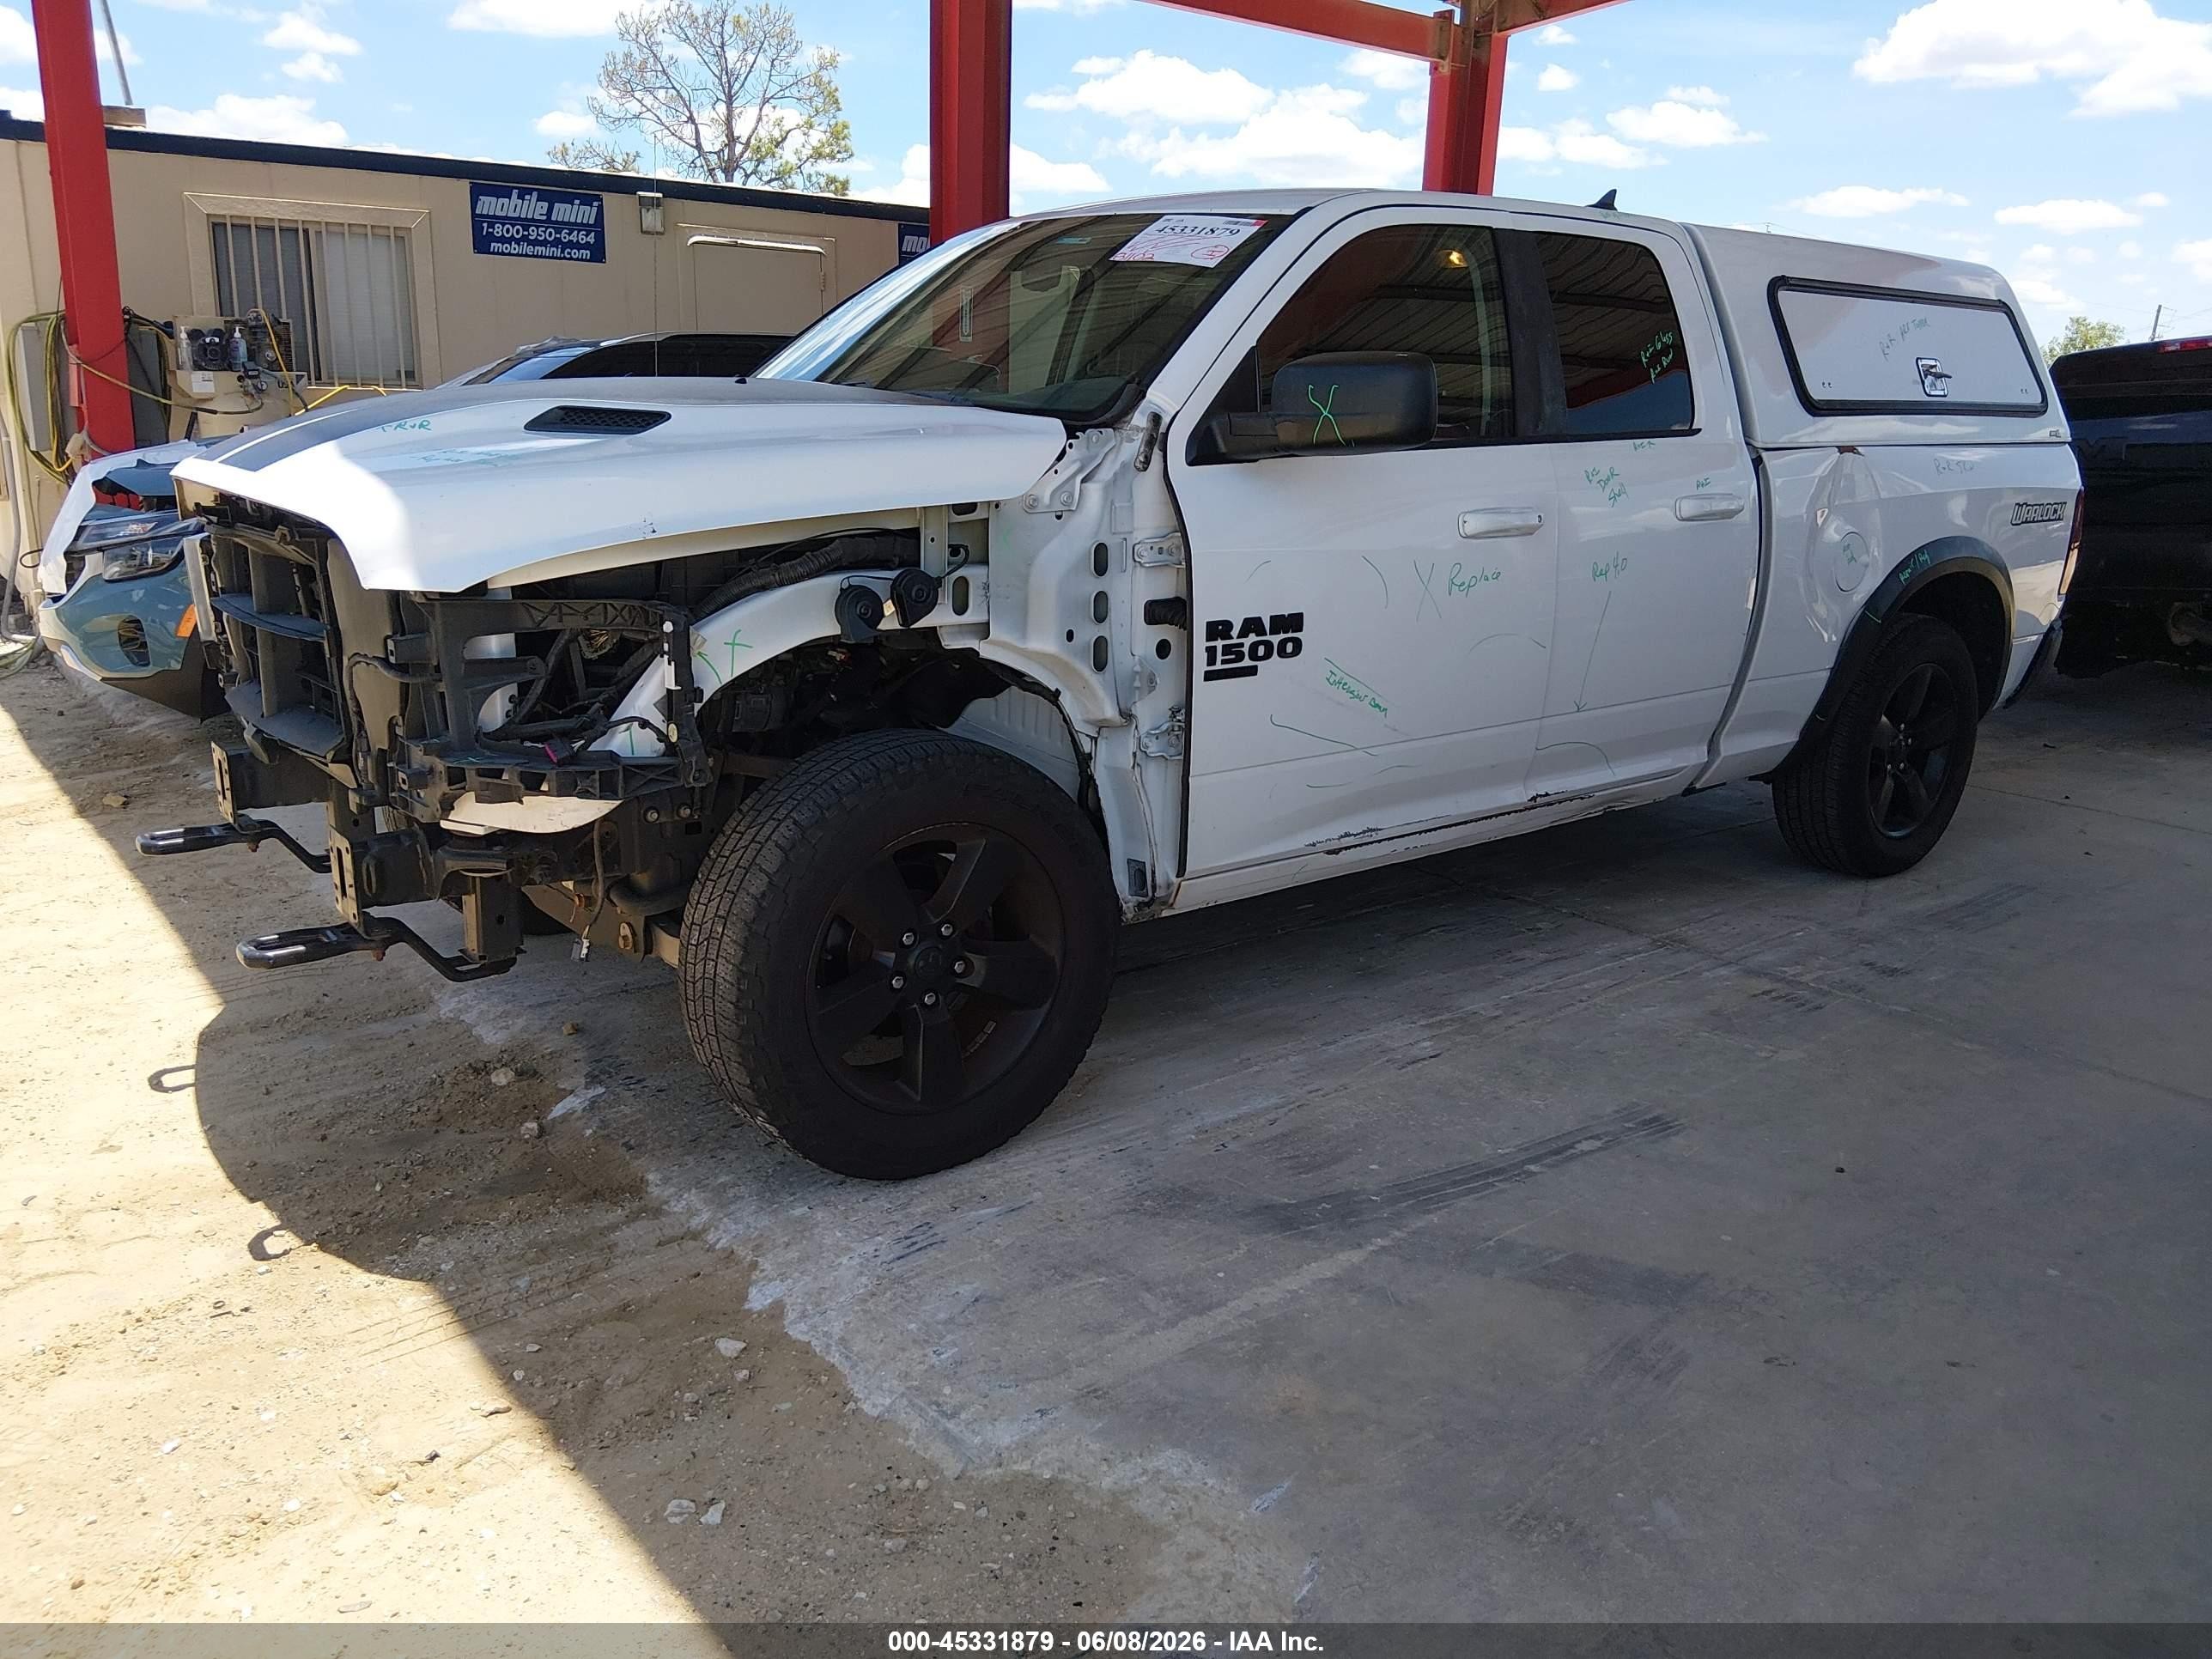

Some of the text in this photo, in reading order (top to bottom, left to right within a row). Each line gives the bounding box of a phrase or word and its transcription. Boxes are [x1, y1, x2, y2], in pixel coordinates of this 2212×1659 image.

[476, 189, 599, 224] mobile mini
[482, 222, 595, 244] 1-800-950-6464
[902, 234, 930, 252] mo
[1156, 225, 1241, 236] 45331879
[490, 241, 591, 259] mobilemini.com
[2010, 501, 2067, 526] WARLOCK
[1448, 562, 1501, 598] Replace
[1206, 612, 1304, 642] RAM
[1205, 636, 1304, 667] 1500
